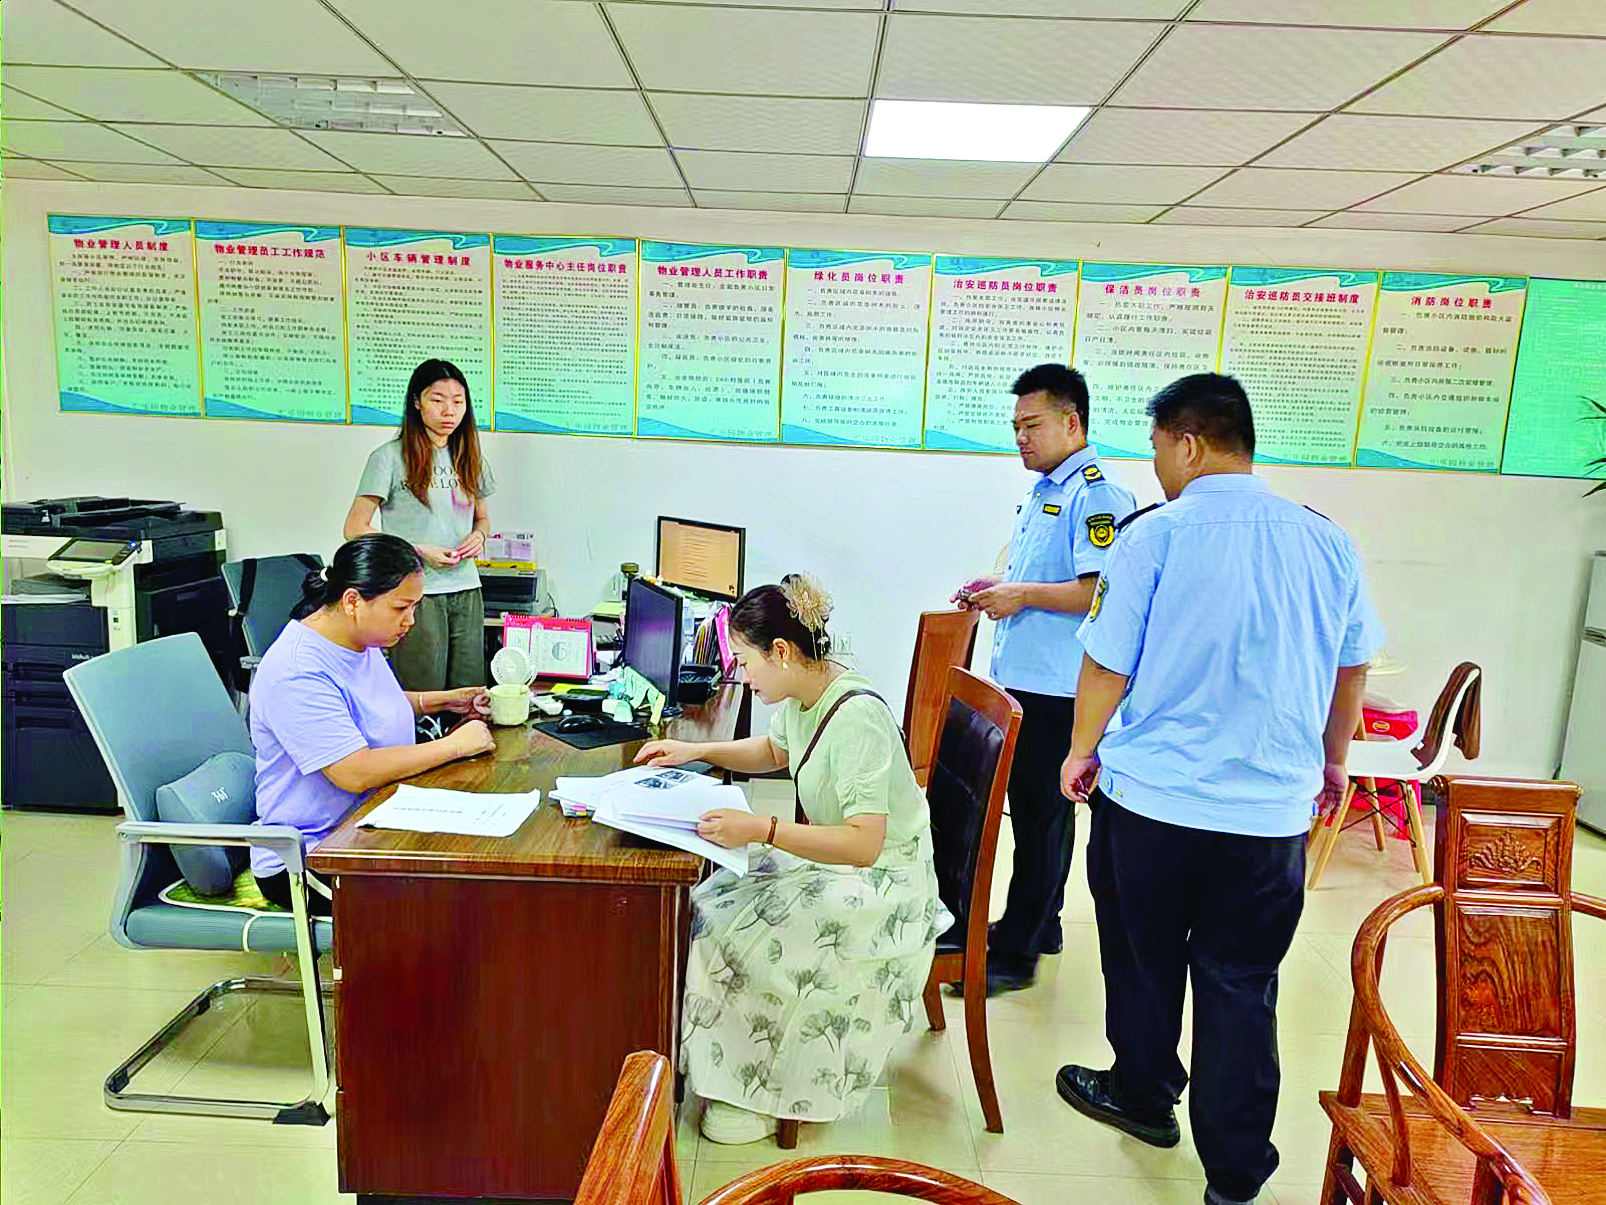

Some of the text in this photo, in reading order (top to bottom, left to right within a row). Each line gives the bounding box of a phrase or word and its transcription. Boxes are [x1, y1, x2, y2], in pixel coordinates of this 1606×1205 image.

[73, 238, 169, 252] 物业管理人员制度
[214, 244, 327, 259] 物业管理员工工作规范
[365, 251, 472, 266] 小区车辆管理制度
[504, 258, 628, 274] 物业服务中心主任岗位职责
[657, 265, 768, 280] 物业管理人员工作职责
[813, 270, 905, 284] 绿化员岗位职责
[953, 278, 1058, 293] 治安巡防员岗位职责
[1104, 284, 1202, 298] 保洁员岗位职责
[1244, 289, 1360, 304] 治安巡防员交接班制度
[1410, 295, 1493, 309] 消防岗位职责
